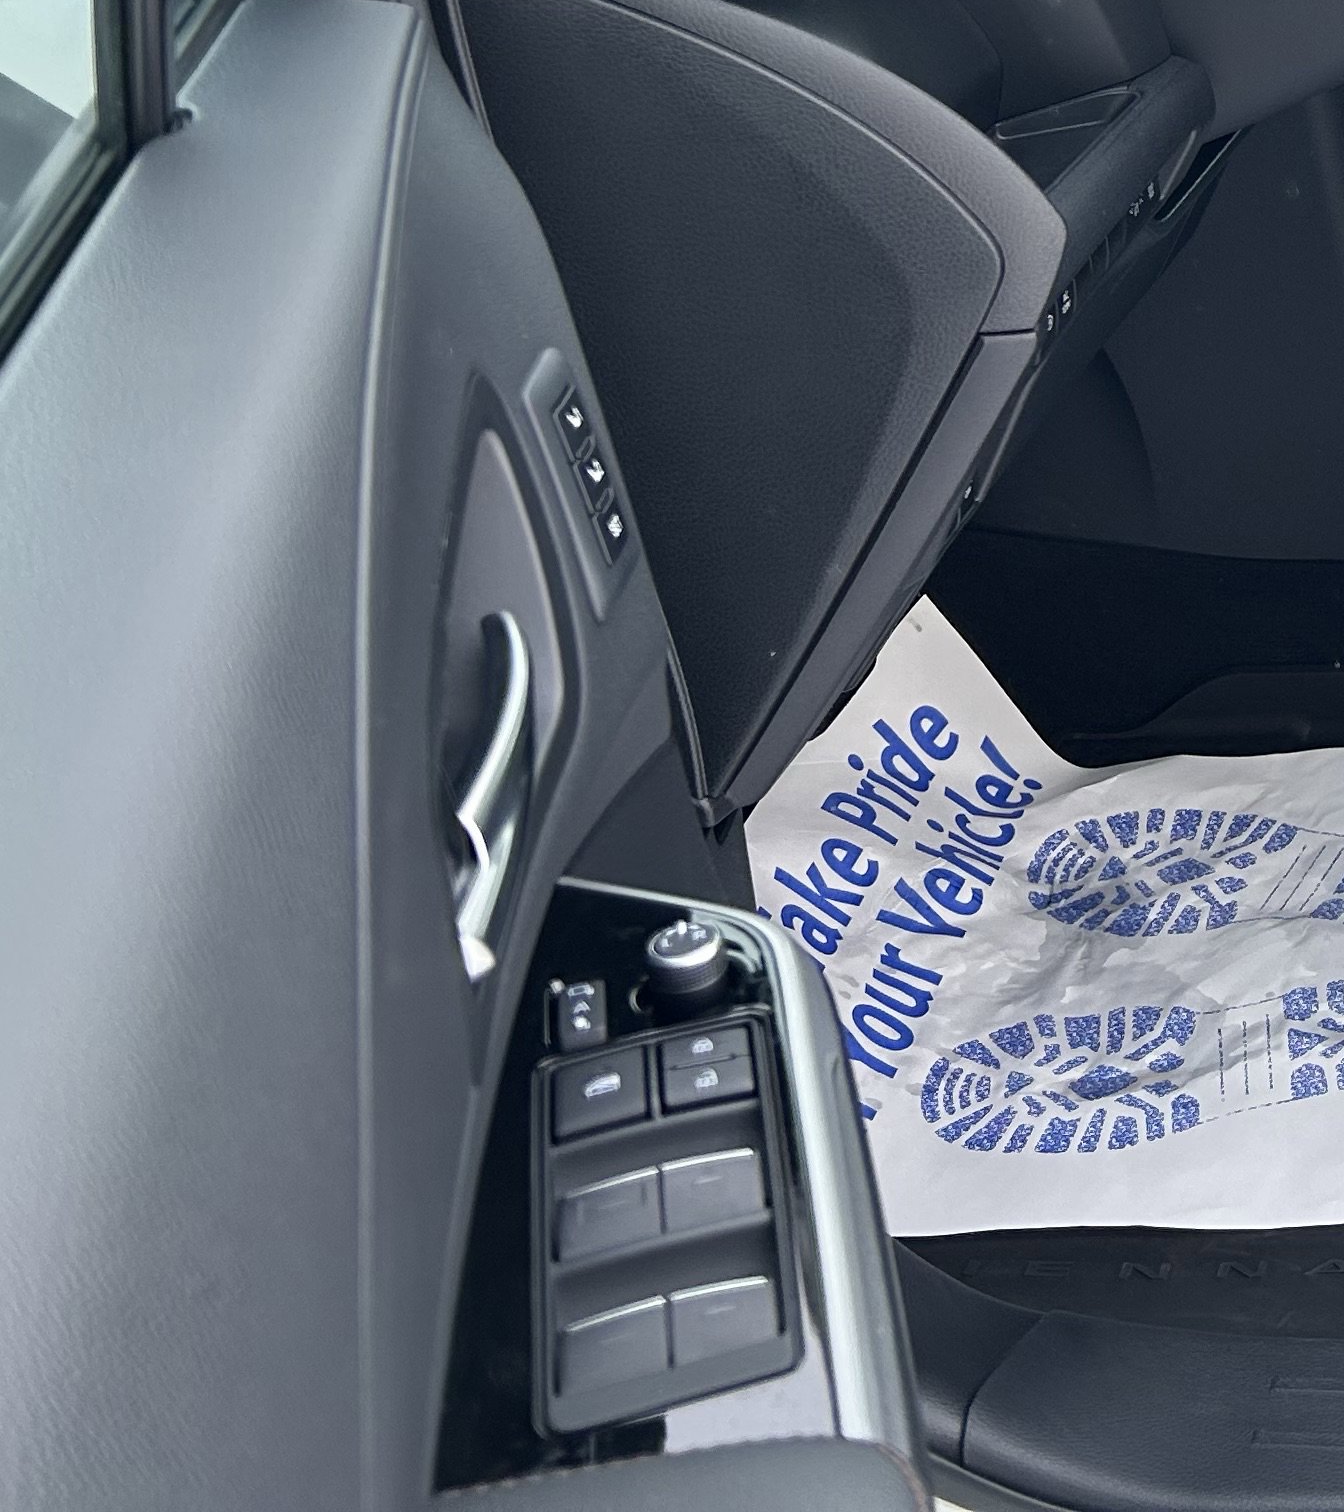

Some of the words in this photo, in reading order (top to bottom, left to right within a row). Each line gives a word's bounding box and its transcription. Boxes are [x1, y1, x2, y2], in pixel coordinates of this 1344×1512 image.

[757, 837, 880, 973] ake
[820, 704, 959, 846] Pride
[875, 734, 1043, 939] Vehicle!
